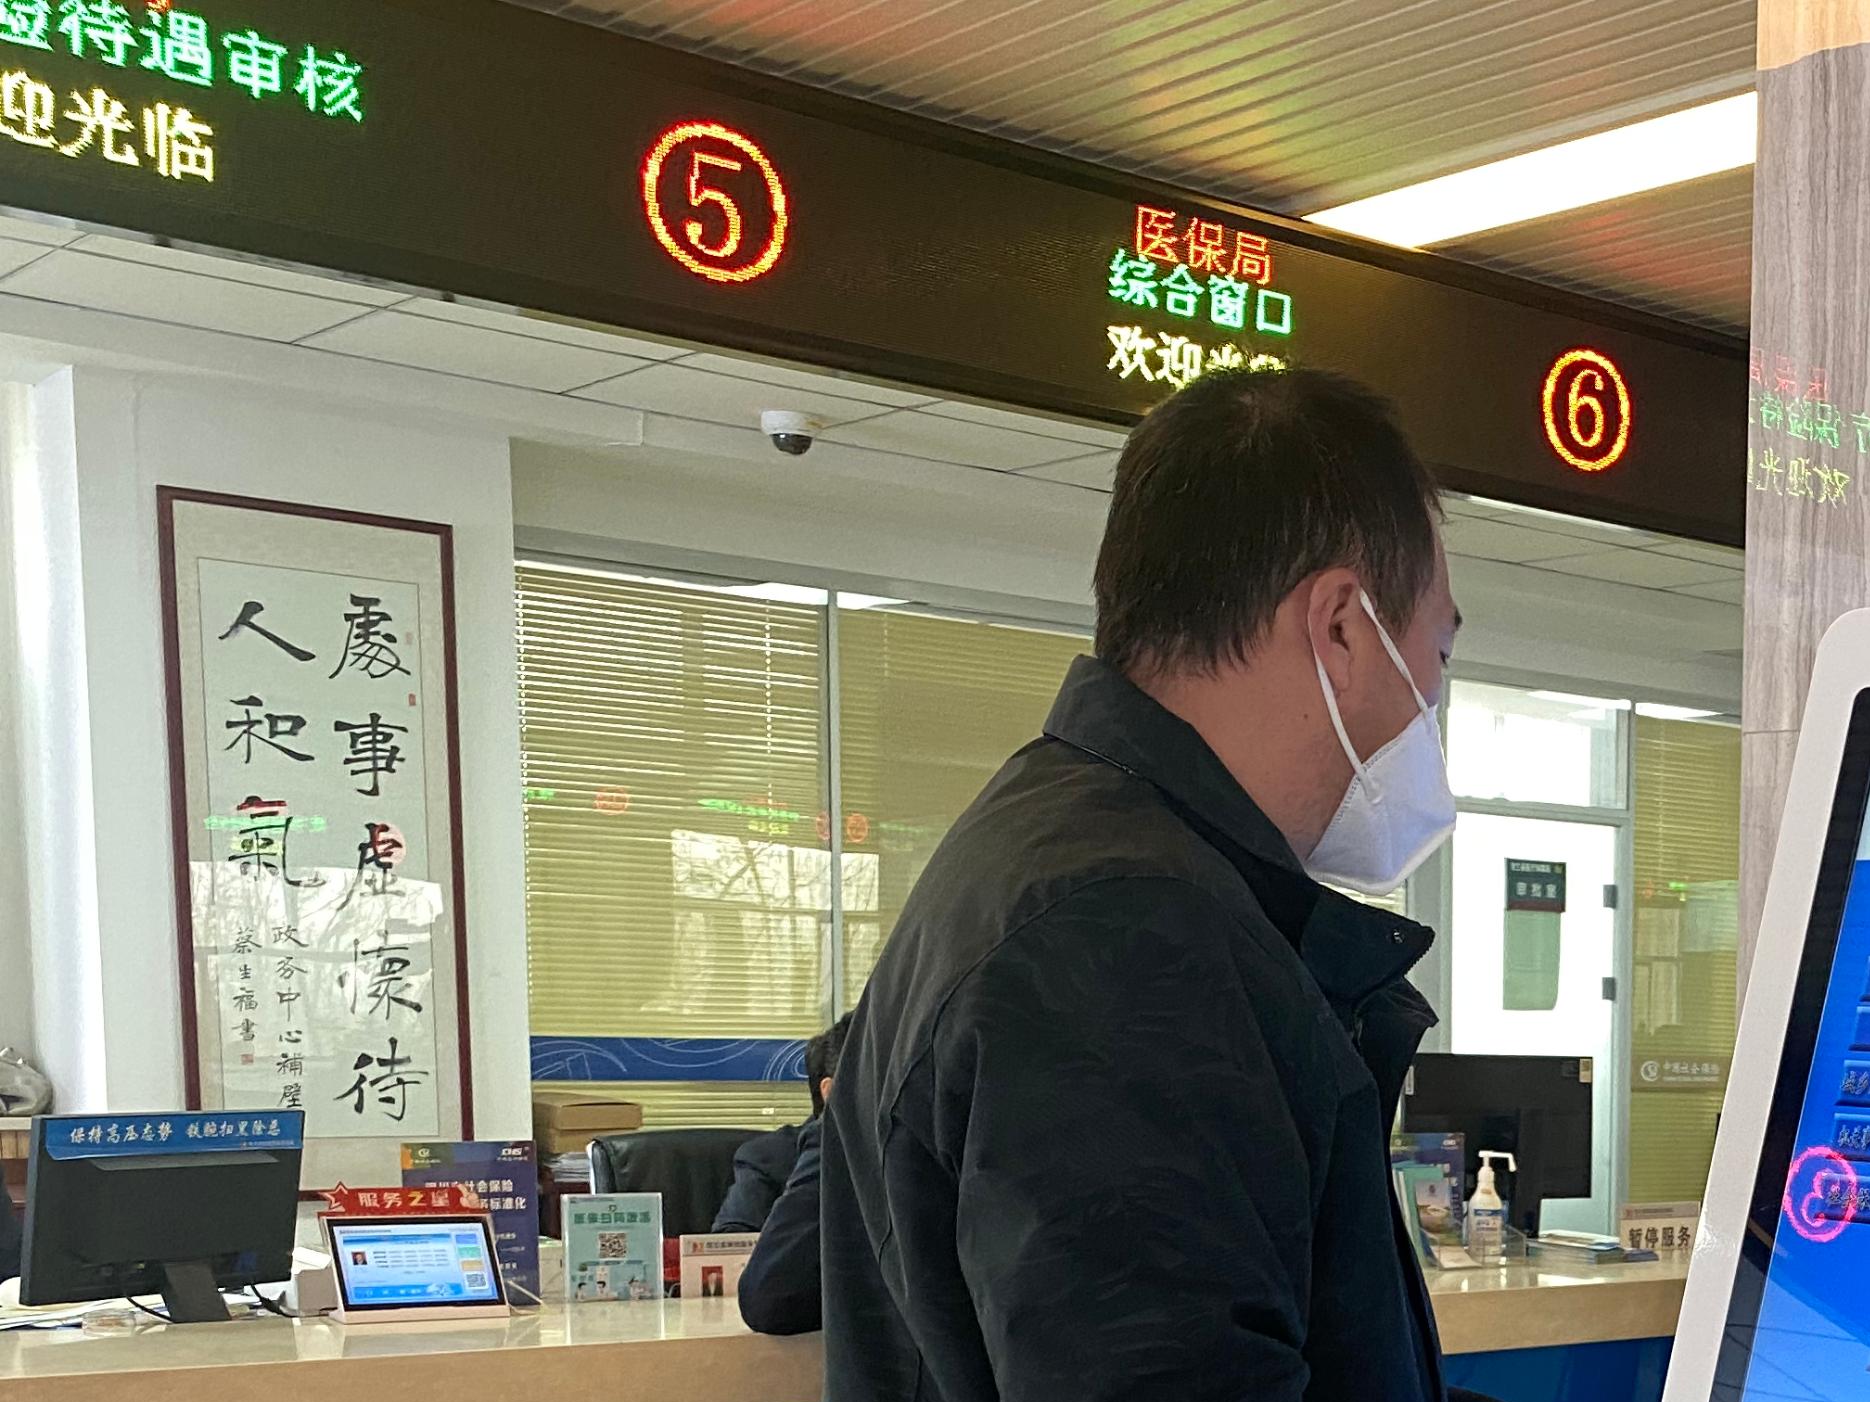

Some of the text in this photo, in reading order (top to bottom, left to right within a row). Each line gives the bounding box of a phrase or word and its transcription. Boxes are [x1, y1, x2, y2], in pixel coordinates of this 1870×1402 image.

[1135, 204, 1273, 286] 医保局
[1108, 248, 1293, 336] 综合窗口
[1106, 325, 1287, 391] 欢迎
[1628, 1226, 1692, 1250] 暂停服务
